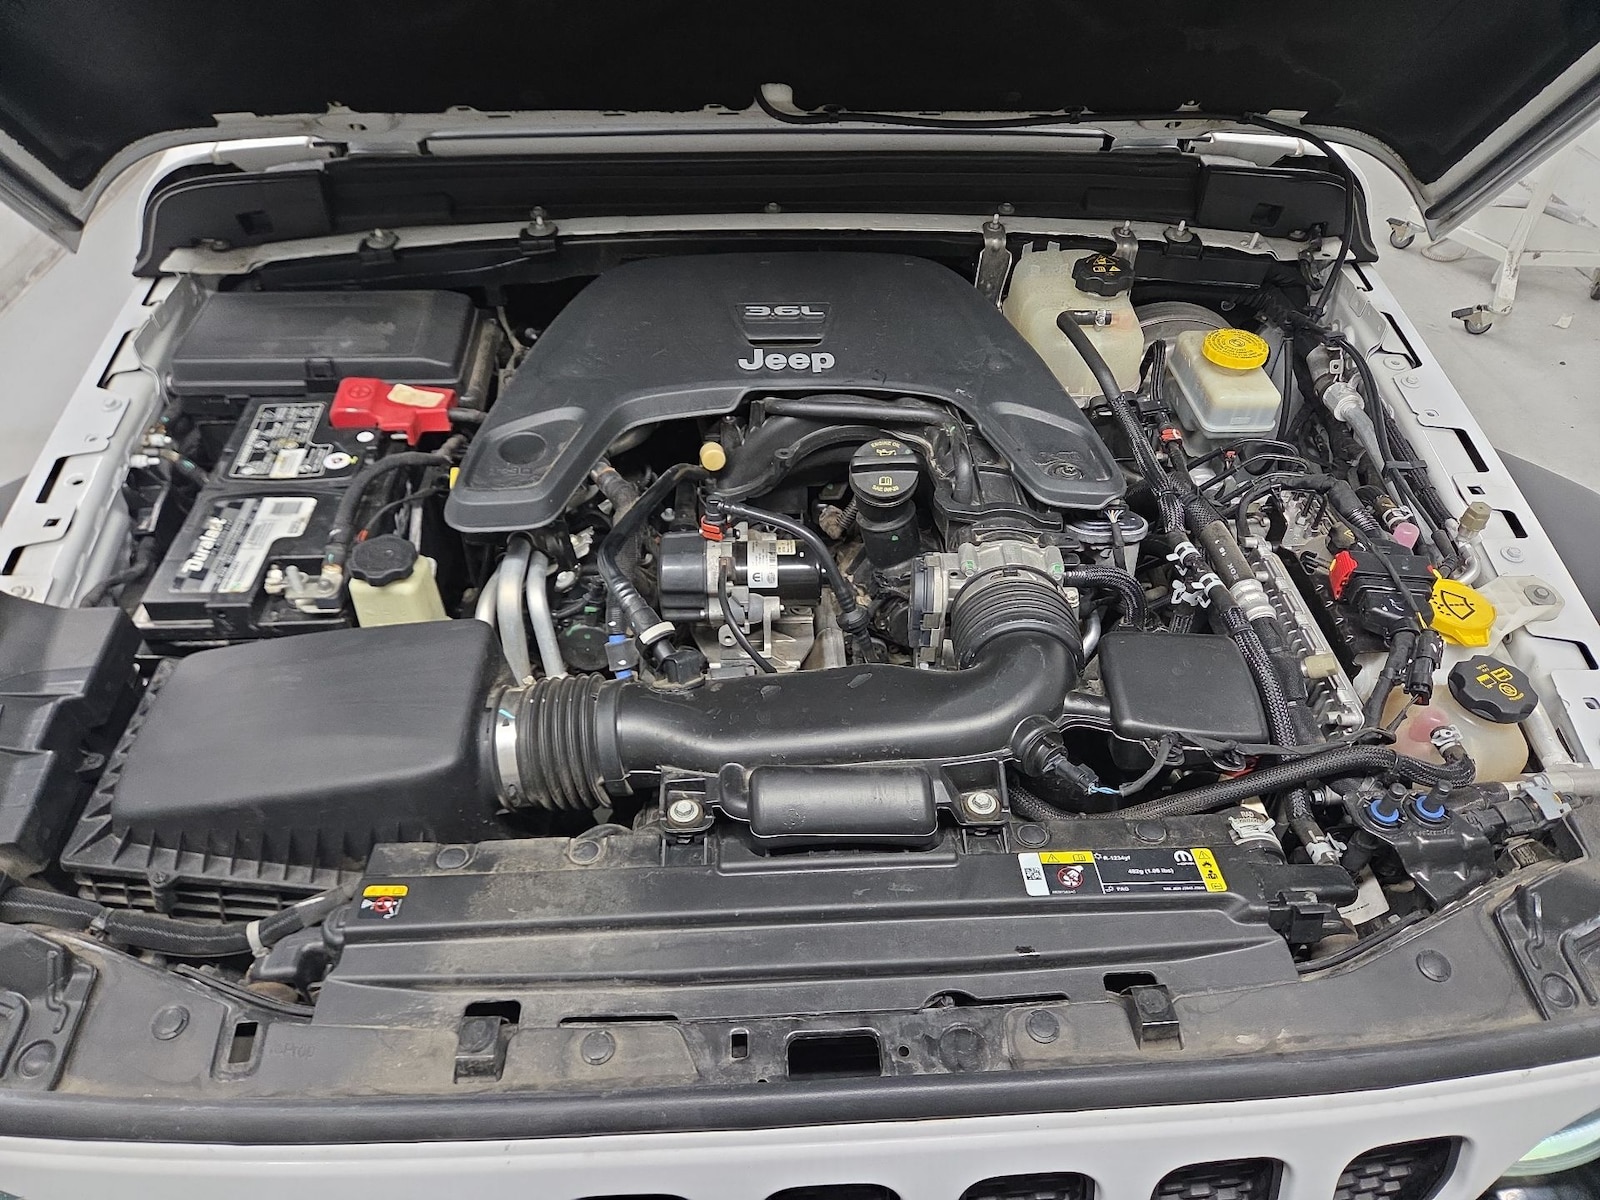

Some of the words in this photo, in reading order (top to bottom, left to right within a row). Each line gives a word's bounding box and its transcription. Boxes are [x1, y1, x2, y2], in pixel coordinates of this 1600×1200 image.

[744, 305, 825, 319] 3.6L
[738, 348, 836, 373] Jeep
[892, 441, 901, 449] OIL
[871, 484, 883, 492] SAE
[180, 515, 228, 574] Duralast
